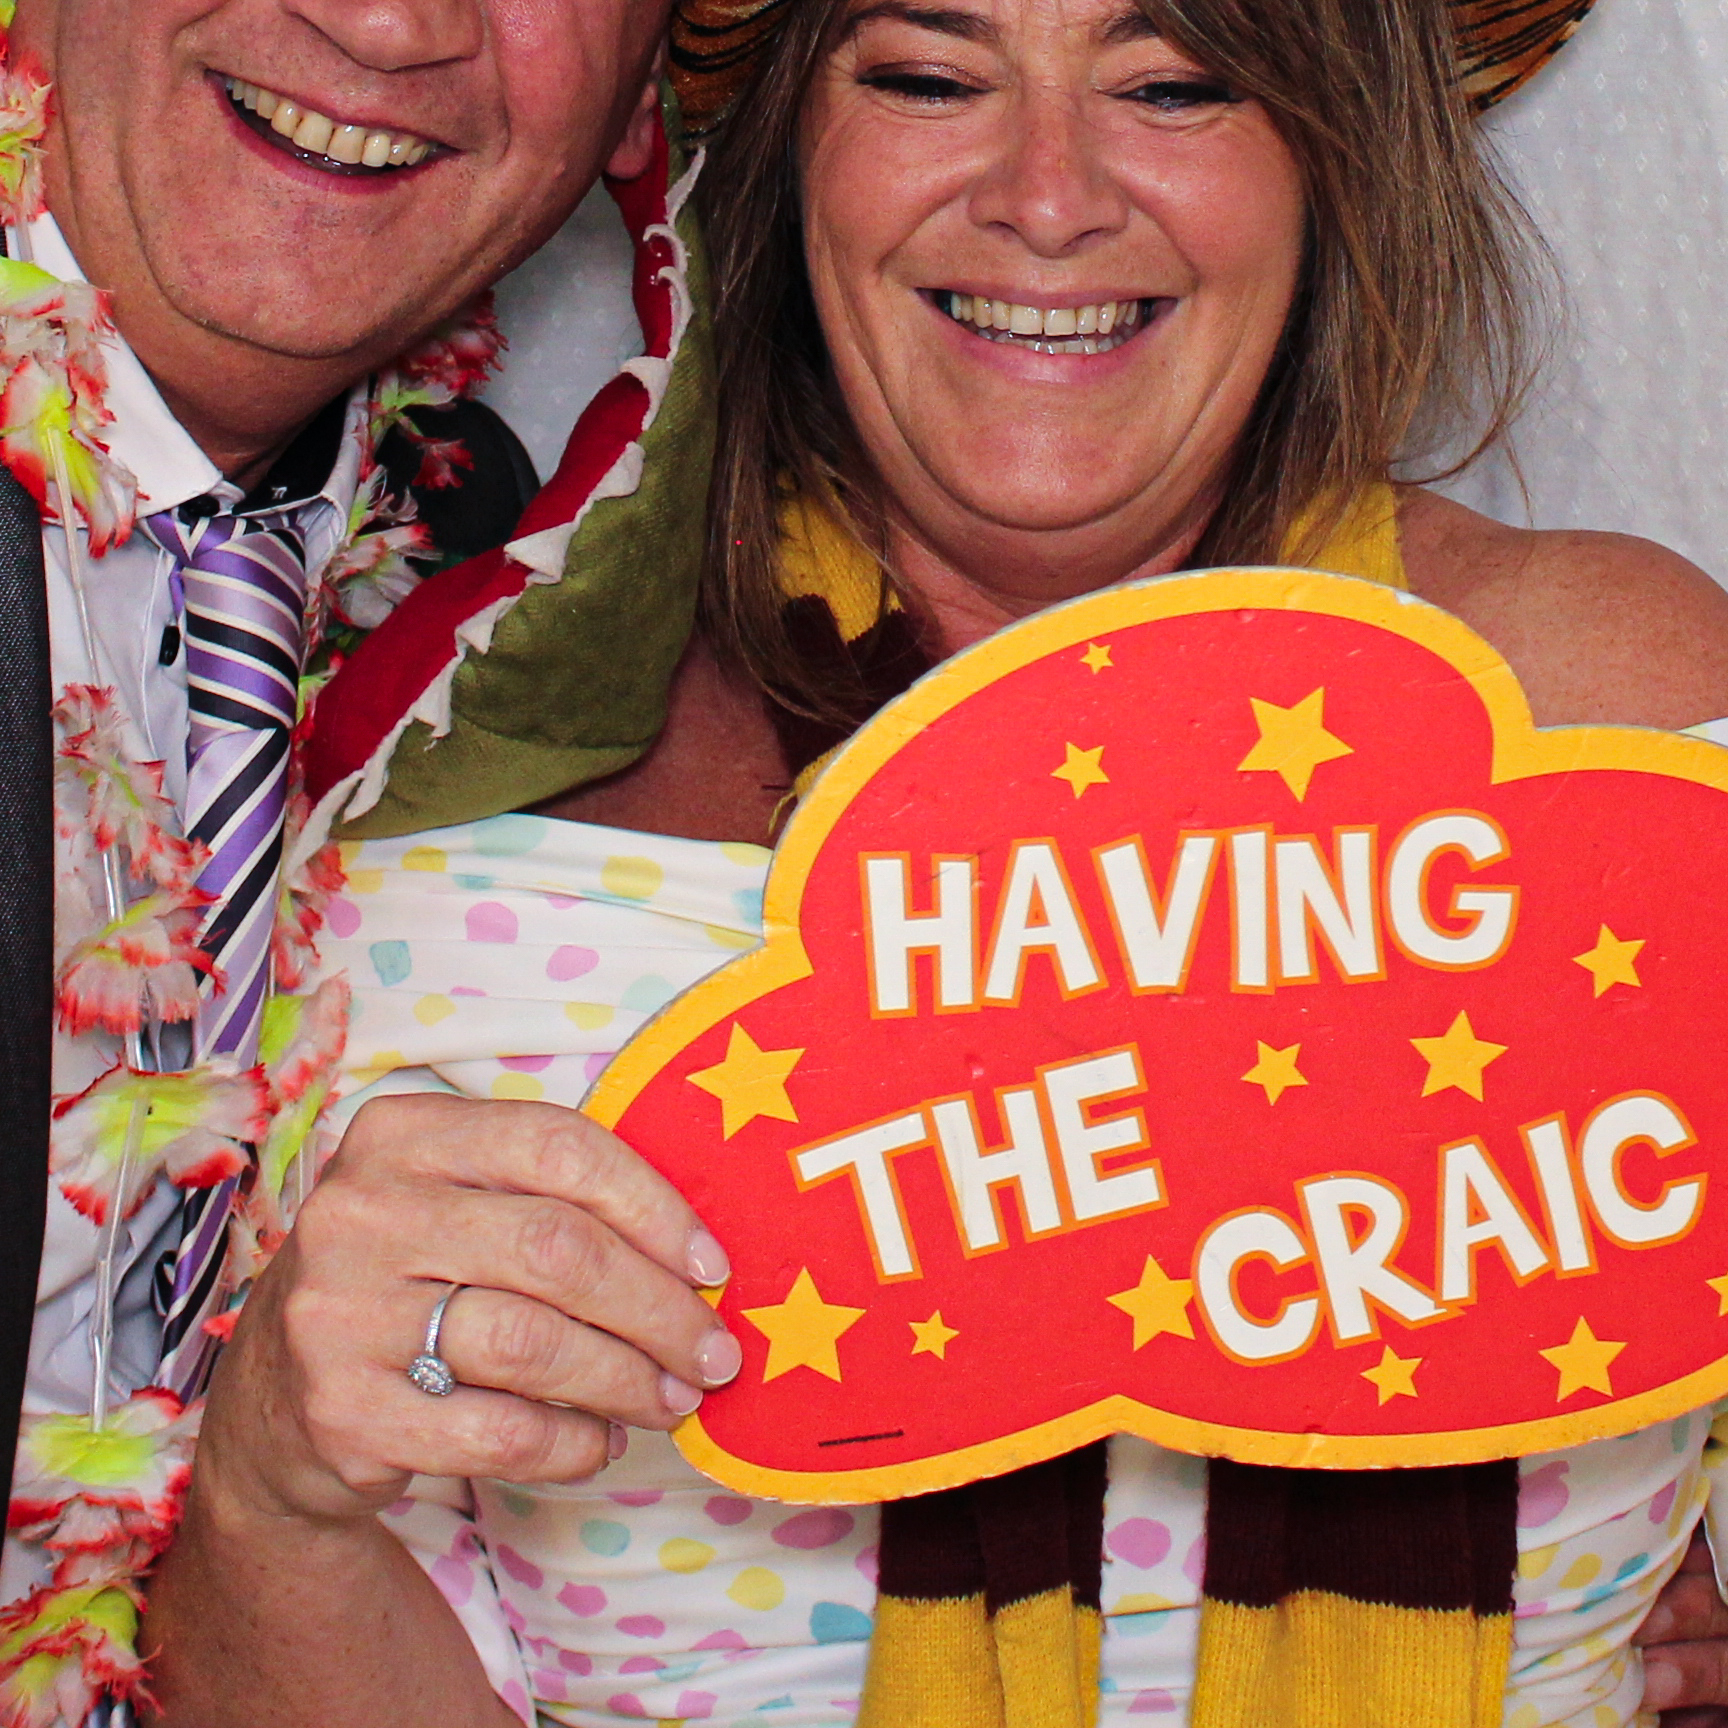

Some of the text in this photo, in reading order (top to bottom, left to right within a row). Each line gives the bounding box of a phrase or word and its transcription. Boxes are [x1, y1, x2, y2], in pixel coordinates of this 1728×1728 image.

[866, 814, 1512, 1011] HAVING
[796, 1050, 1700, 1360] THE CRAIC
